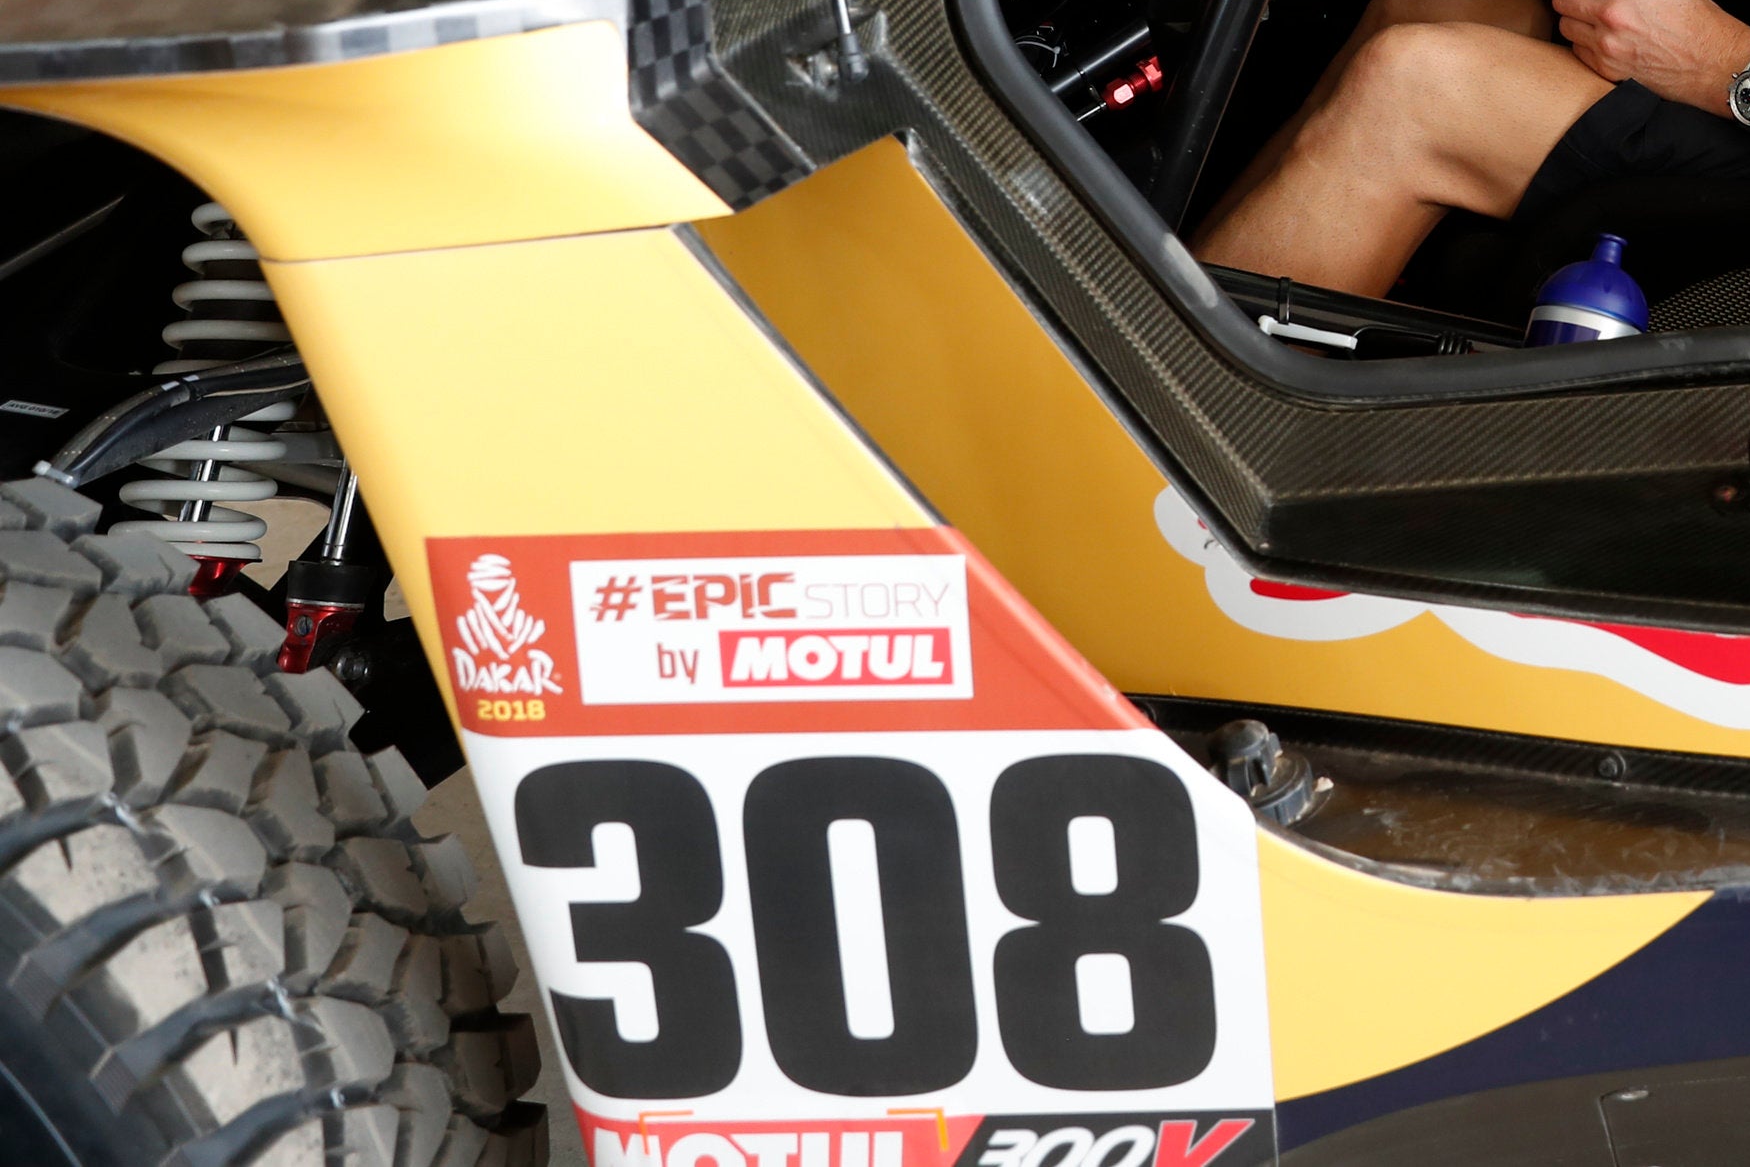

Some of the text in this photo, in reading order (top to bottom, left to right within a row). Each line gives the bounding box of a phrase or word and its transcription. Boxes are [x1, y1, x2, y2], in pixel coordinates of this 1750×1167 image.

[452, 647, 564, 696] DAKAR
[656, 634, 945, 684] by MOTUL
[477, 699, 546, 721] 2018
[514, 752, 1217, 1100] 308
